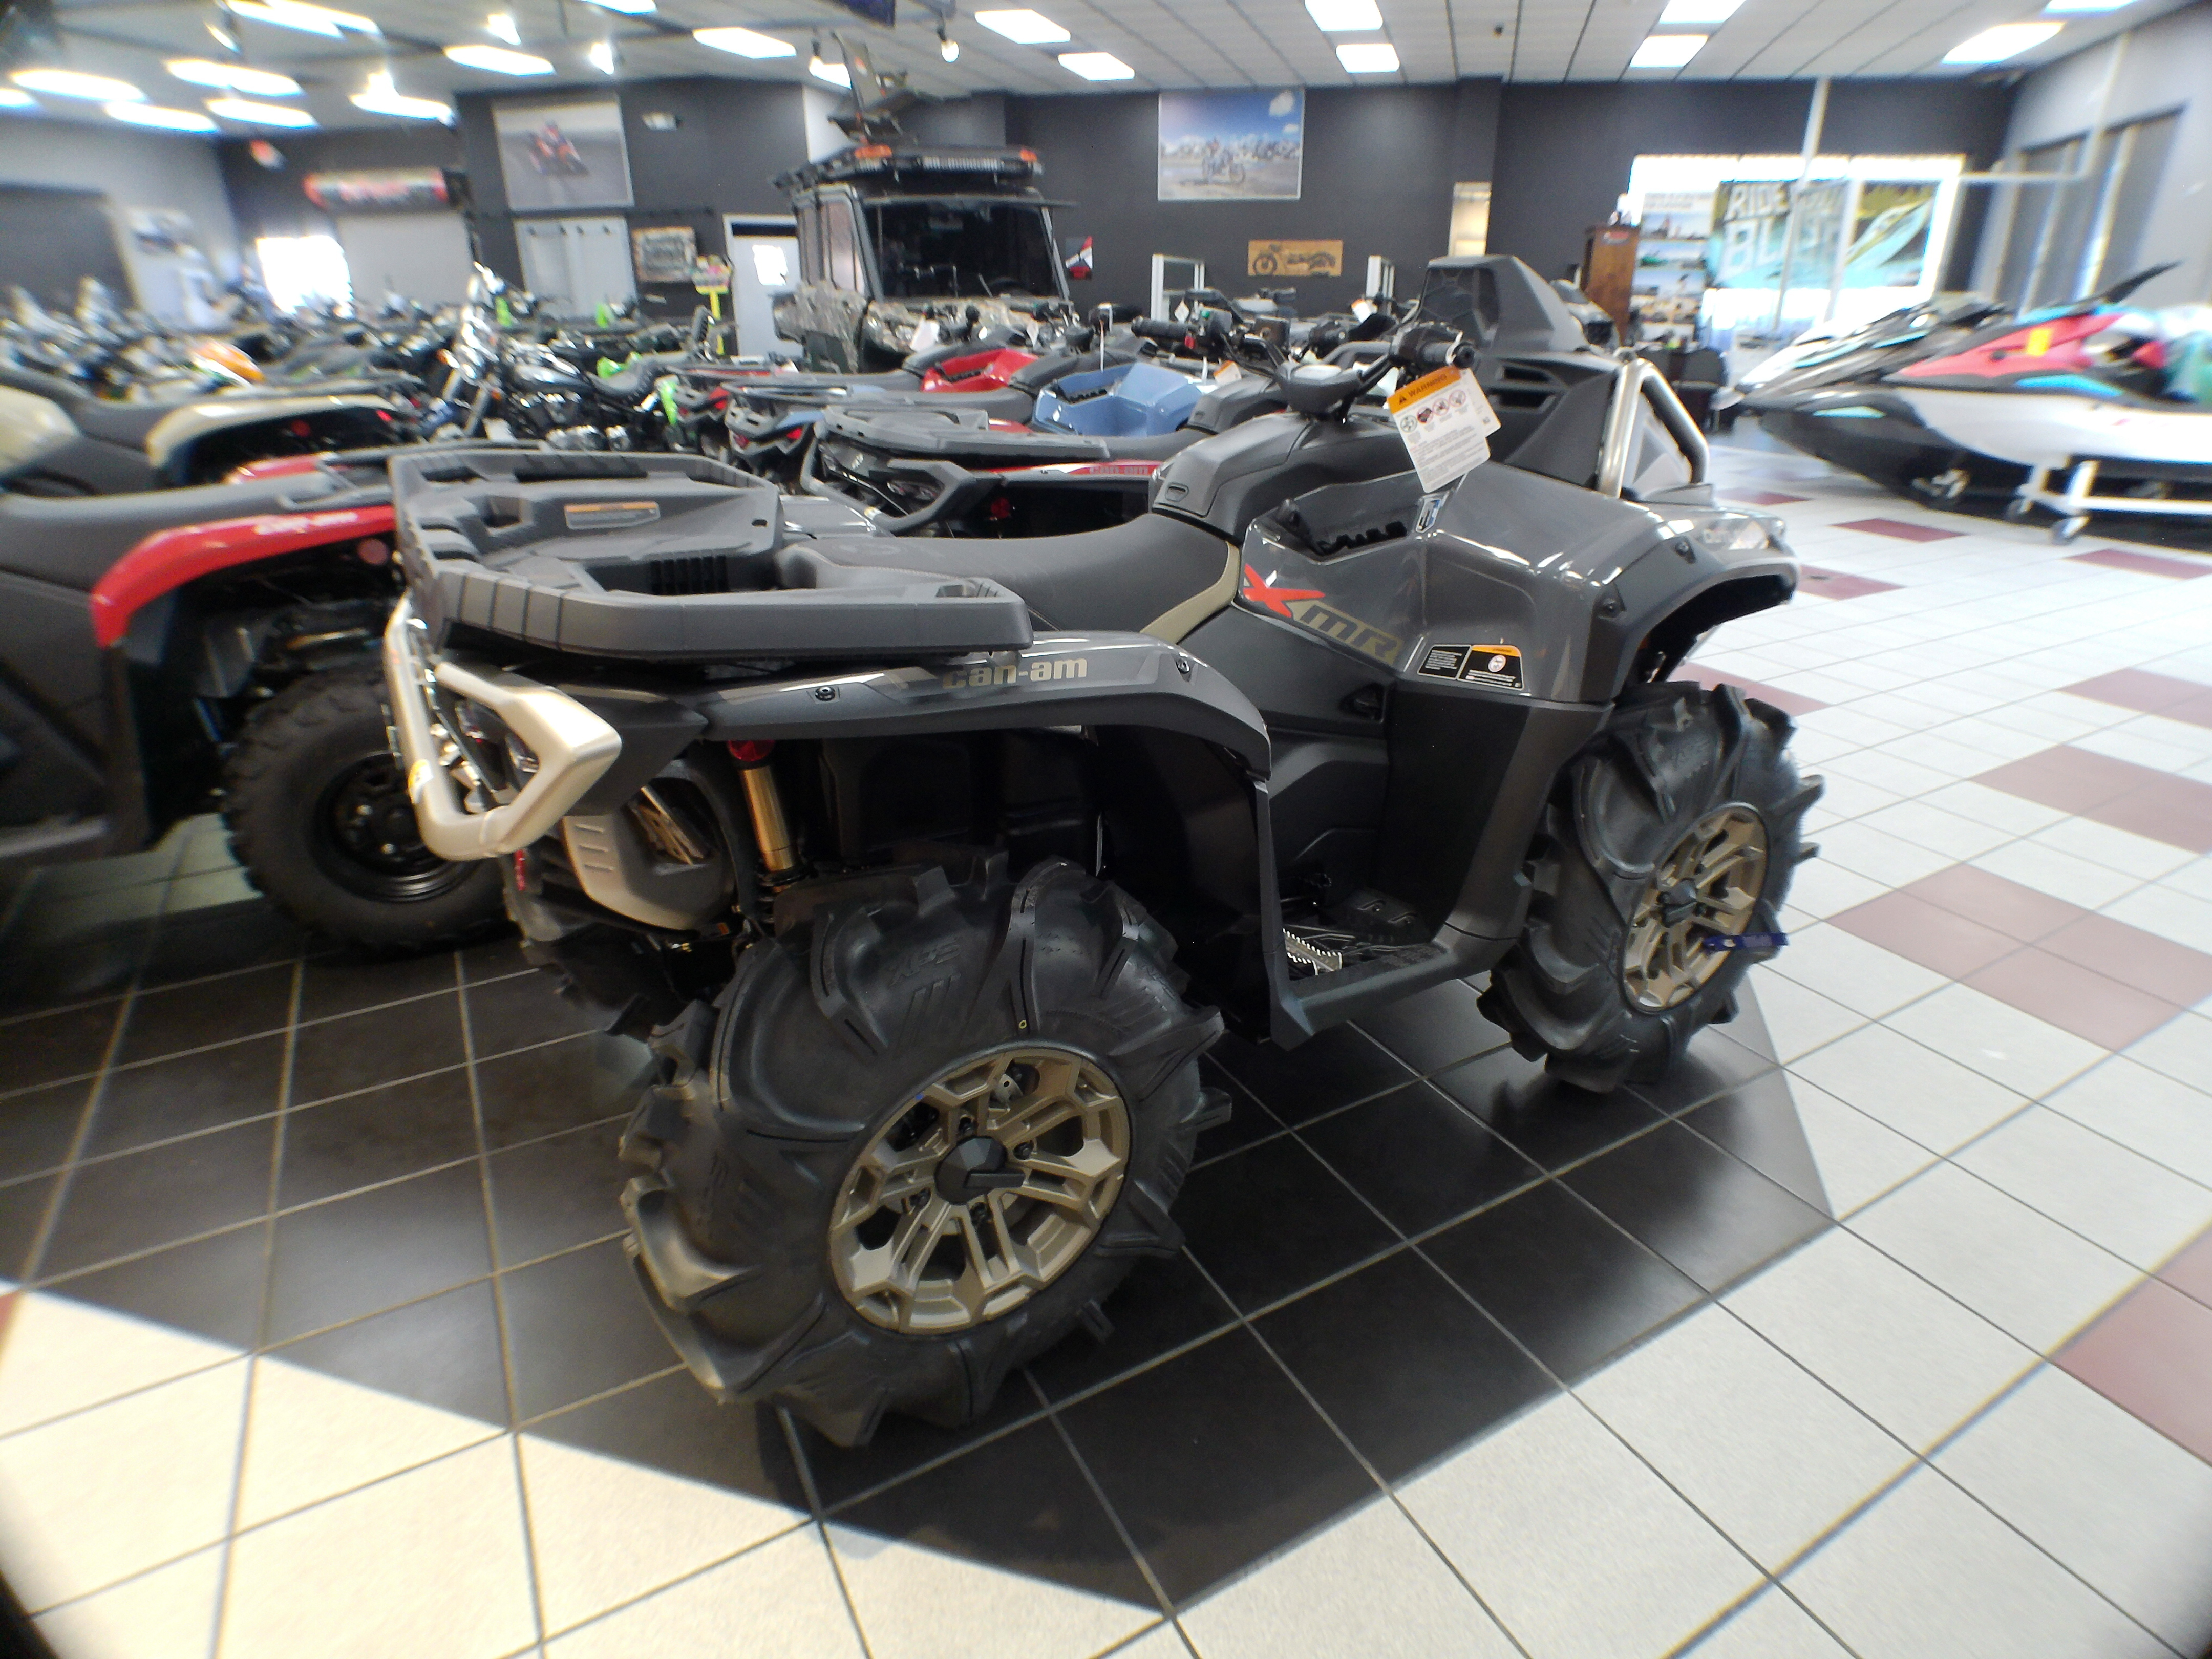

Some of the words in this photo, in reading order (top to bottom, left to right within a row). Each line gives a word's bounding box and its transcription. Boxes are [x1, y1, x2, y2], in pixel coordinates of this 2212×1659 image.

[1724, 183, 1789, 221] RIDE
[1408, 373, 1447, 397] WARNING
[942, 657, 1088, 689] can-am
